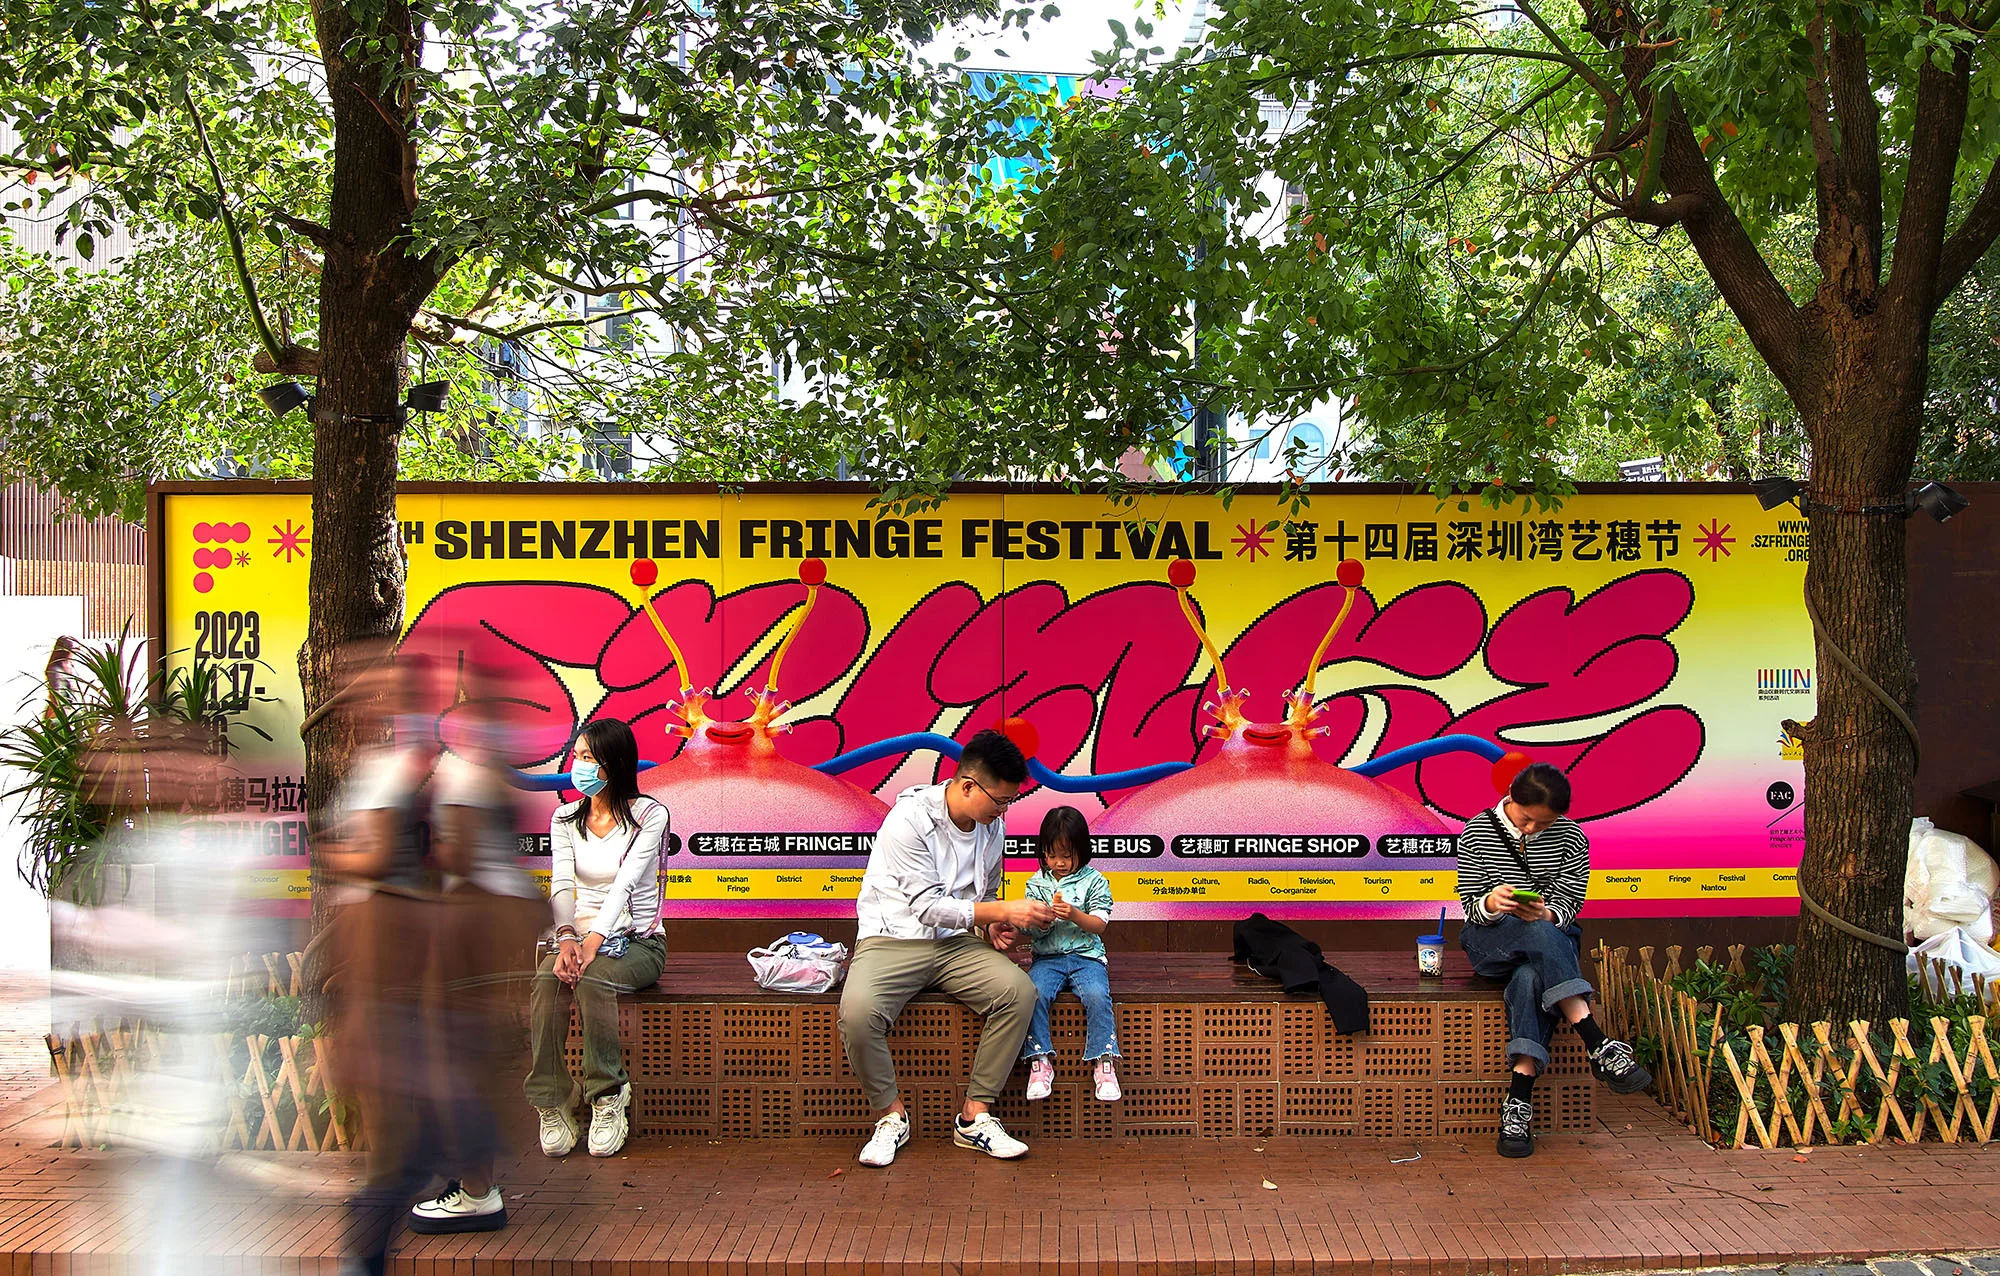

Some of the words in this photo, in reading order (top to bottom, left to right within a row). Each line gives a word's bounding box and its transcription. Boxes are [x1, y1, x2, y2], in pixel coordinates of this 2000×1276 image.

[398, 521, 424, 544] H
[435, 519, 720, 560] SHENZHEN
[739, 519, 943, 559] FRINGE
[962, 518, 1222, 560] FESTIVAL
[195, 611, 260, 660] 2023
[1770, 791, 1792, 800] FAC
[698, 836, 780, 853] 艺穗在古城
[785, 836, 853, 851] FRINGE
[1114, 838, 1151, 854] BUS
[1180, 838, 1230, 855] 艺穗町
[1234, 838, 1303, 853] FRINGE
[1313, 838, 1360, 854] SHOP
[1385, 837, 1452, 855] 艺穗在场
[717, 875, 749, 883] Nanshan
[776, 875, 802, 883] District
[1138, 877, 1164, 885] District
[1192, 877, 1221, 886] Culture,
[1248, 877, 1271, 886] Radio,
[1298, 877, 1336, 886] Television,
[1364, 877, 1393, 885] Tourism
[1420, 877, 1434, 885] and
[1606, 875, 1642, 884] Shenzhen
[1669, 875, 1692, 884] Fringe
[1719, 874, 1746, 883] Festival
[727, 884, 751, 894] Fringe
[822, 884, 834, 892] Art
[1152, 887, 1207, 895] 分会场协办单位
[1270, 886, 1317, 895] Co-organizer
[1700, 884, 1727, 892] Nantou
